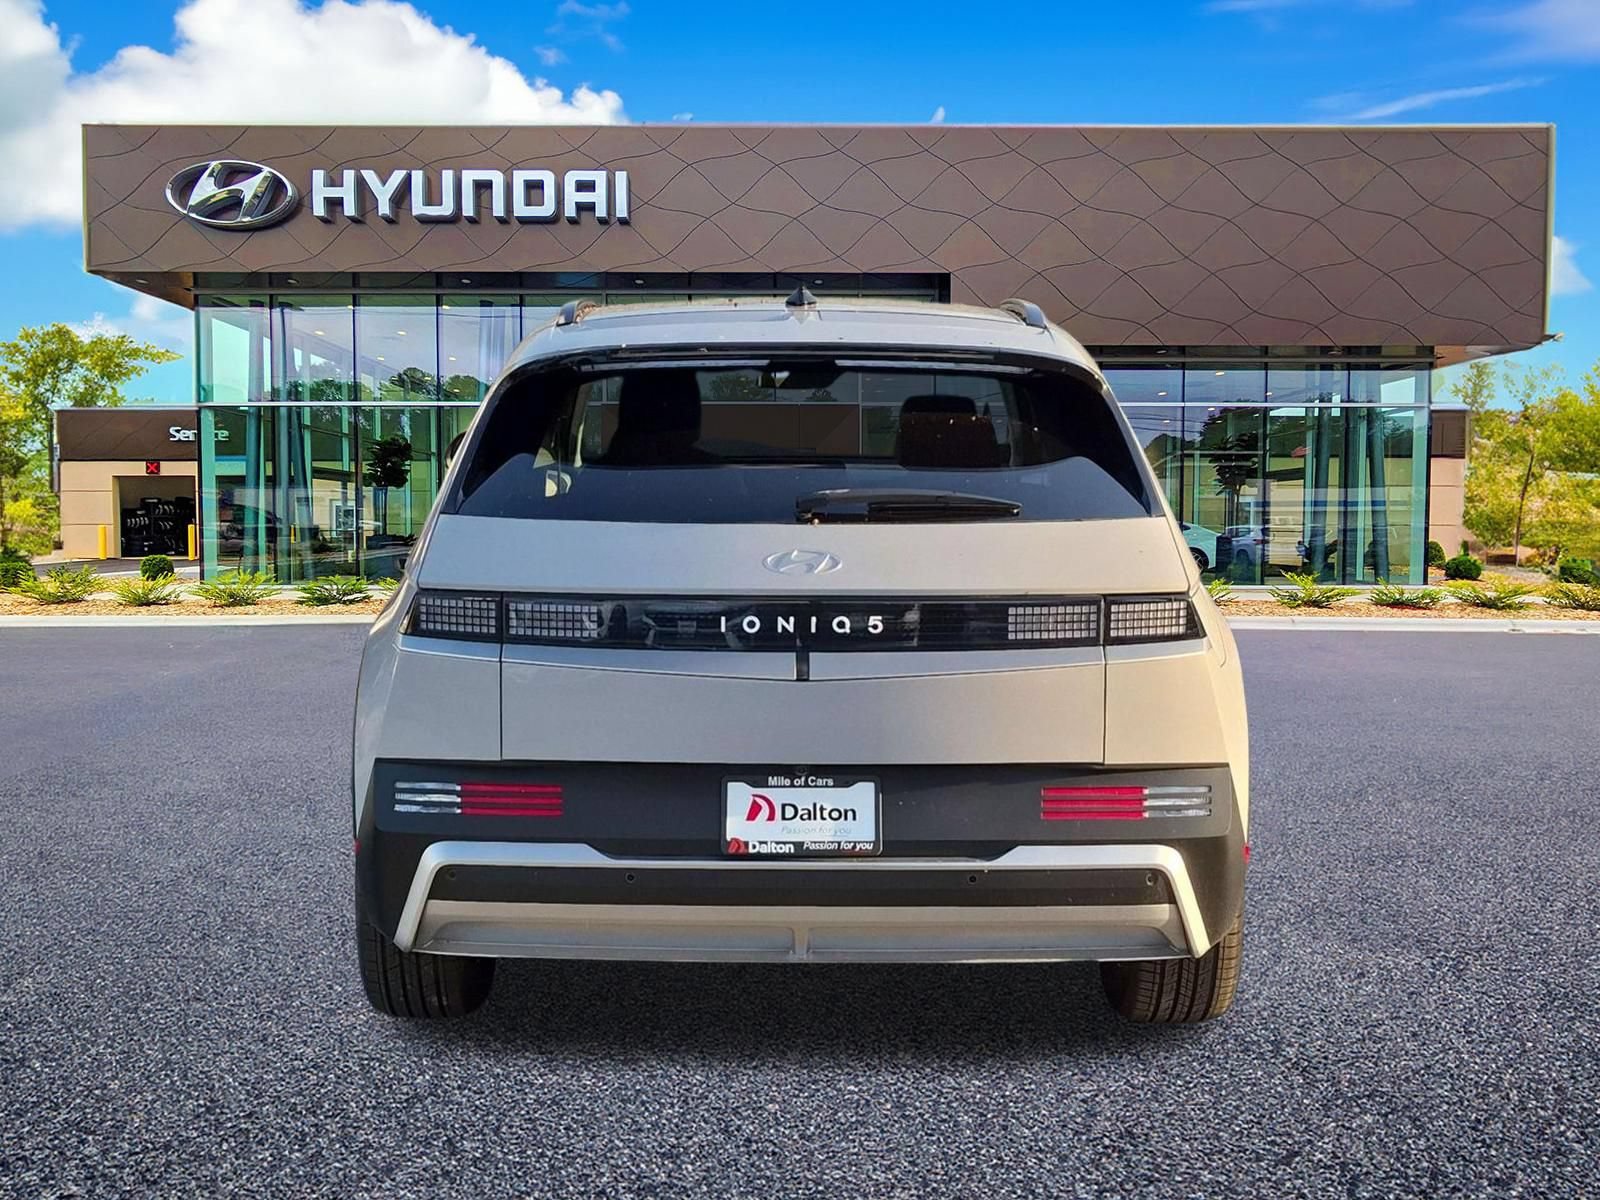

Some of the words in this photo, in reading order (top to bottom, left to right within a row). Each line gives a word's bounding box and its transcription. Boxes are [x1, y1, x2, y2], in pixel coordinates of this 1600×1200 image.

[312, 169, 630, 221] HYUNDAI
[169, 426, 229, 441] Sere
[768, 776, 791, 786] Mile
[793, 776, 806, 786] of
[808, 776, 834, 786] Cars
[781, 802, 857, 822] Dalton
[748, 841, 795, 854] Dalton
[803, 841, 838, 850] Passion
[839, 841, 854, 850] for
[854, 842, 874, 851] you
